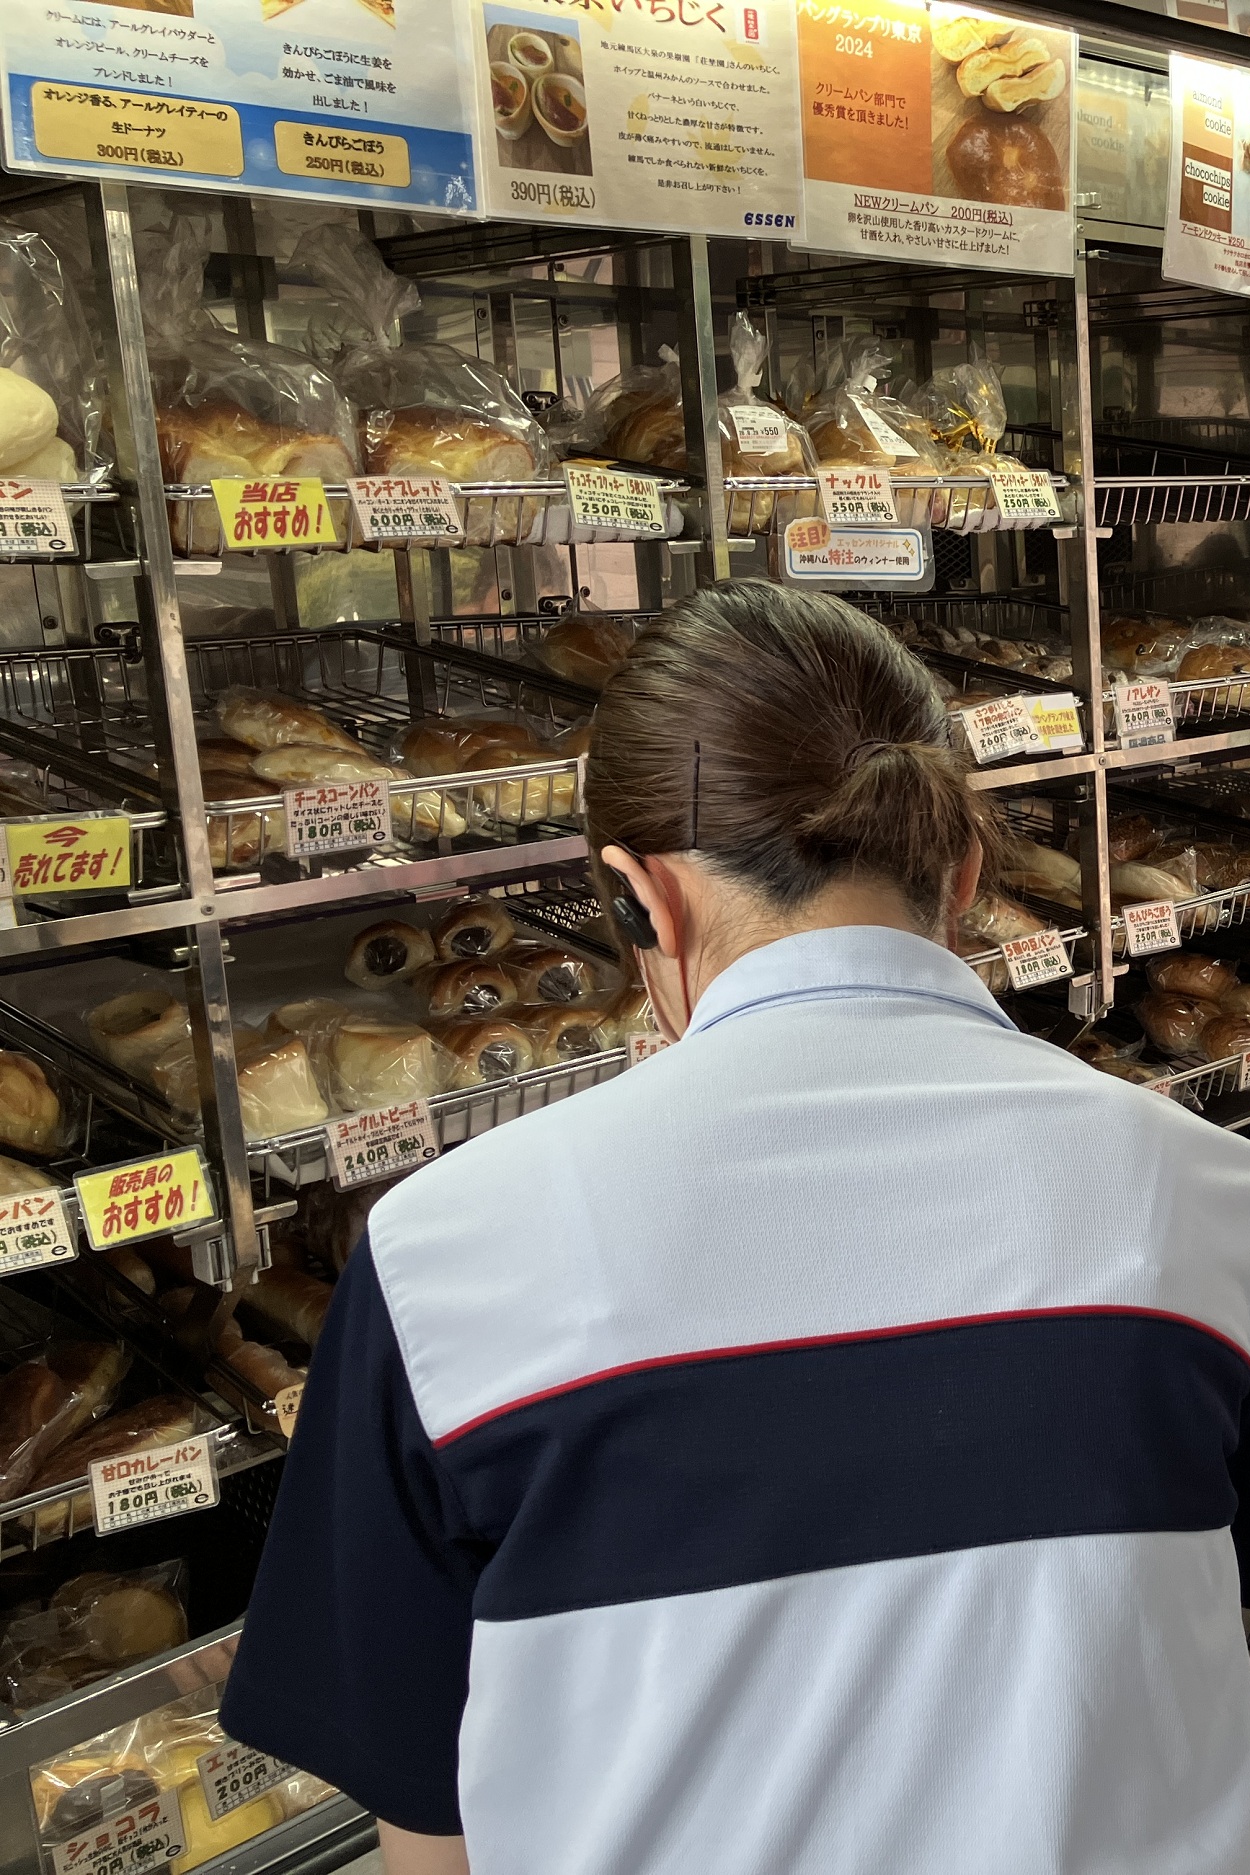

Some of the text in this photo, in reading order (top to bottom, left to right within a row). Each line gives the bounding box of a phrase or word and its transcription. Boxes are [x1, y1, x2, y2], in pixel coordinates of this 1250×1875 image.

[835, 34, 874, 59] 2024
[282, 66, 397, 94] 効かせ、ごま油で風味を
[43, 89, 228, 122] オレンジ香る、アールグレイティーの
[815, 81, 907, 109] クリームパン部門で
[111, 121, 167, 139] 生ドーナツ
[1205, 115, 1232, 136] cookie
[302, 132, 386, 156] きんぴらごぼう
[1185, 162, 1231, 190] chocochips
[510, 180, 595, 209] 390円(税込)
[1203, 190, 1230, 208] cookie
[744, 212, 795, 229] ESSEN
[854, 193, 1013, 226] NEWクリームパン 200円(税込)
[240, 482, 300, 504] 当店
[356, 480, 443, 498] ランチブレッド
[826, 474, 882, 490] ナックル
[837, 538, 900, 548] エッセンオリジナル
[42, 825, 89, 848] 今
[1129, 905, 1172, 923] きんぴらごぼう
[338, 1101, 419, 1138] ヨーグルトピーチ
[109, 1163, 173, 1198] 販売員の
[101, 1445, 202, 1483] 甘口カレーパン
[205, 1746, 247, 1774] エッ
[67, 1801, 161, 1861] ショコラ
